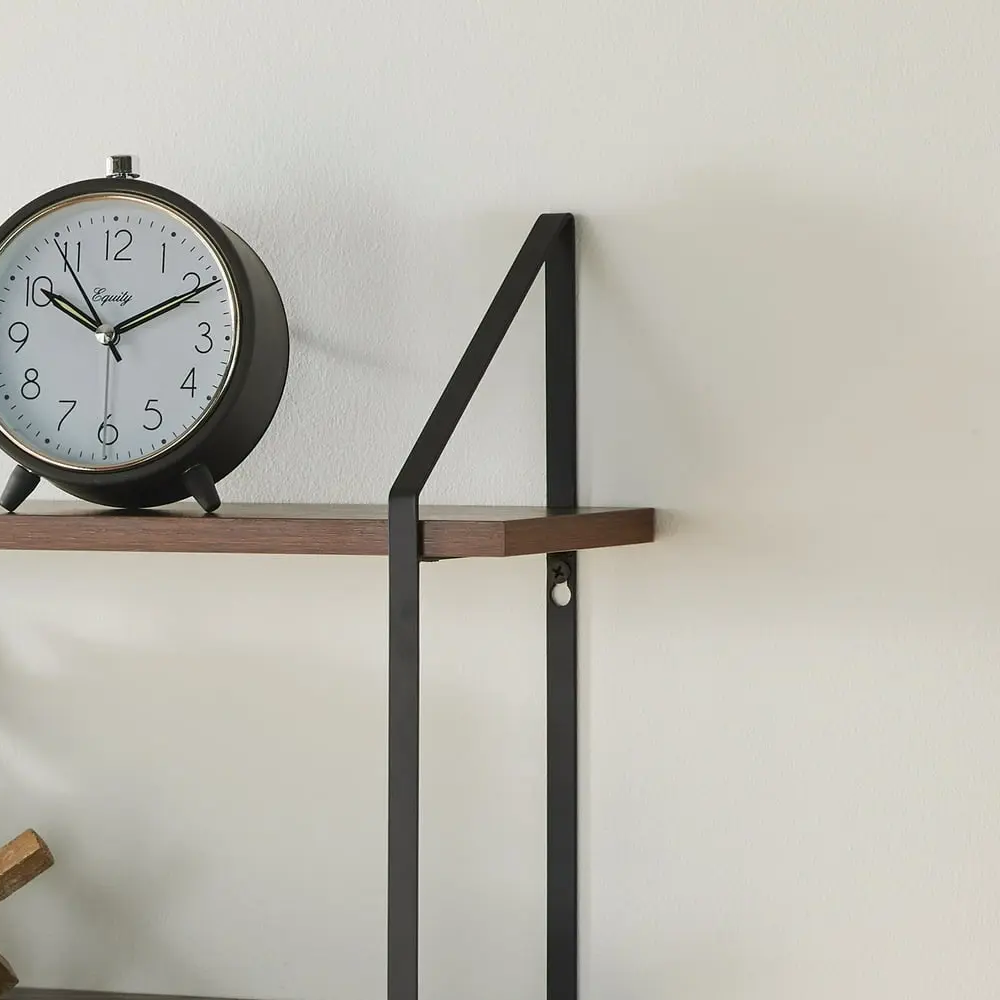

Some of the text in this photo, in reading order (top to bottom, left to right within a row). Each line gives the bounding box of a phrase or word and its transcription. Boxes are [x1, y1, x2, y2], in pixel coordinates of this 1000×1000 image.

[63, 241, 82, 273] 11
[105, 229, 134, 261] 12
[161, 242, 166, 274] 1
[25, 276, 53, 308] 10
[91, 287, 133, 306] Equity
[182, 272, 201, 304] 2
[8, 321, 30, 354] 9
[194, 321, 214, 354] 3
[20, 368, 42, 401] 8
[180, 367, 198, 398] 4
[58, 400, 78, 432] 7
[97, 413, 119, 446] 6
[142, 399, 163, 431] 5
